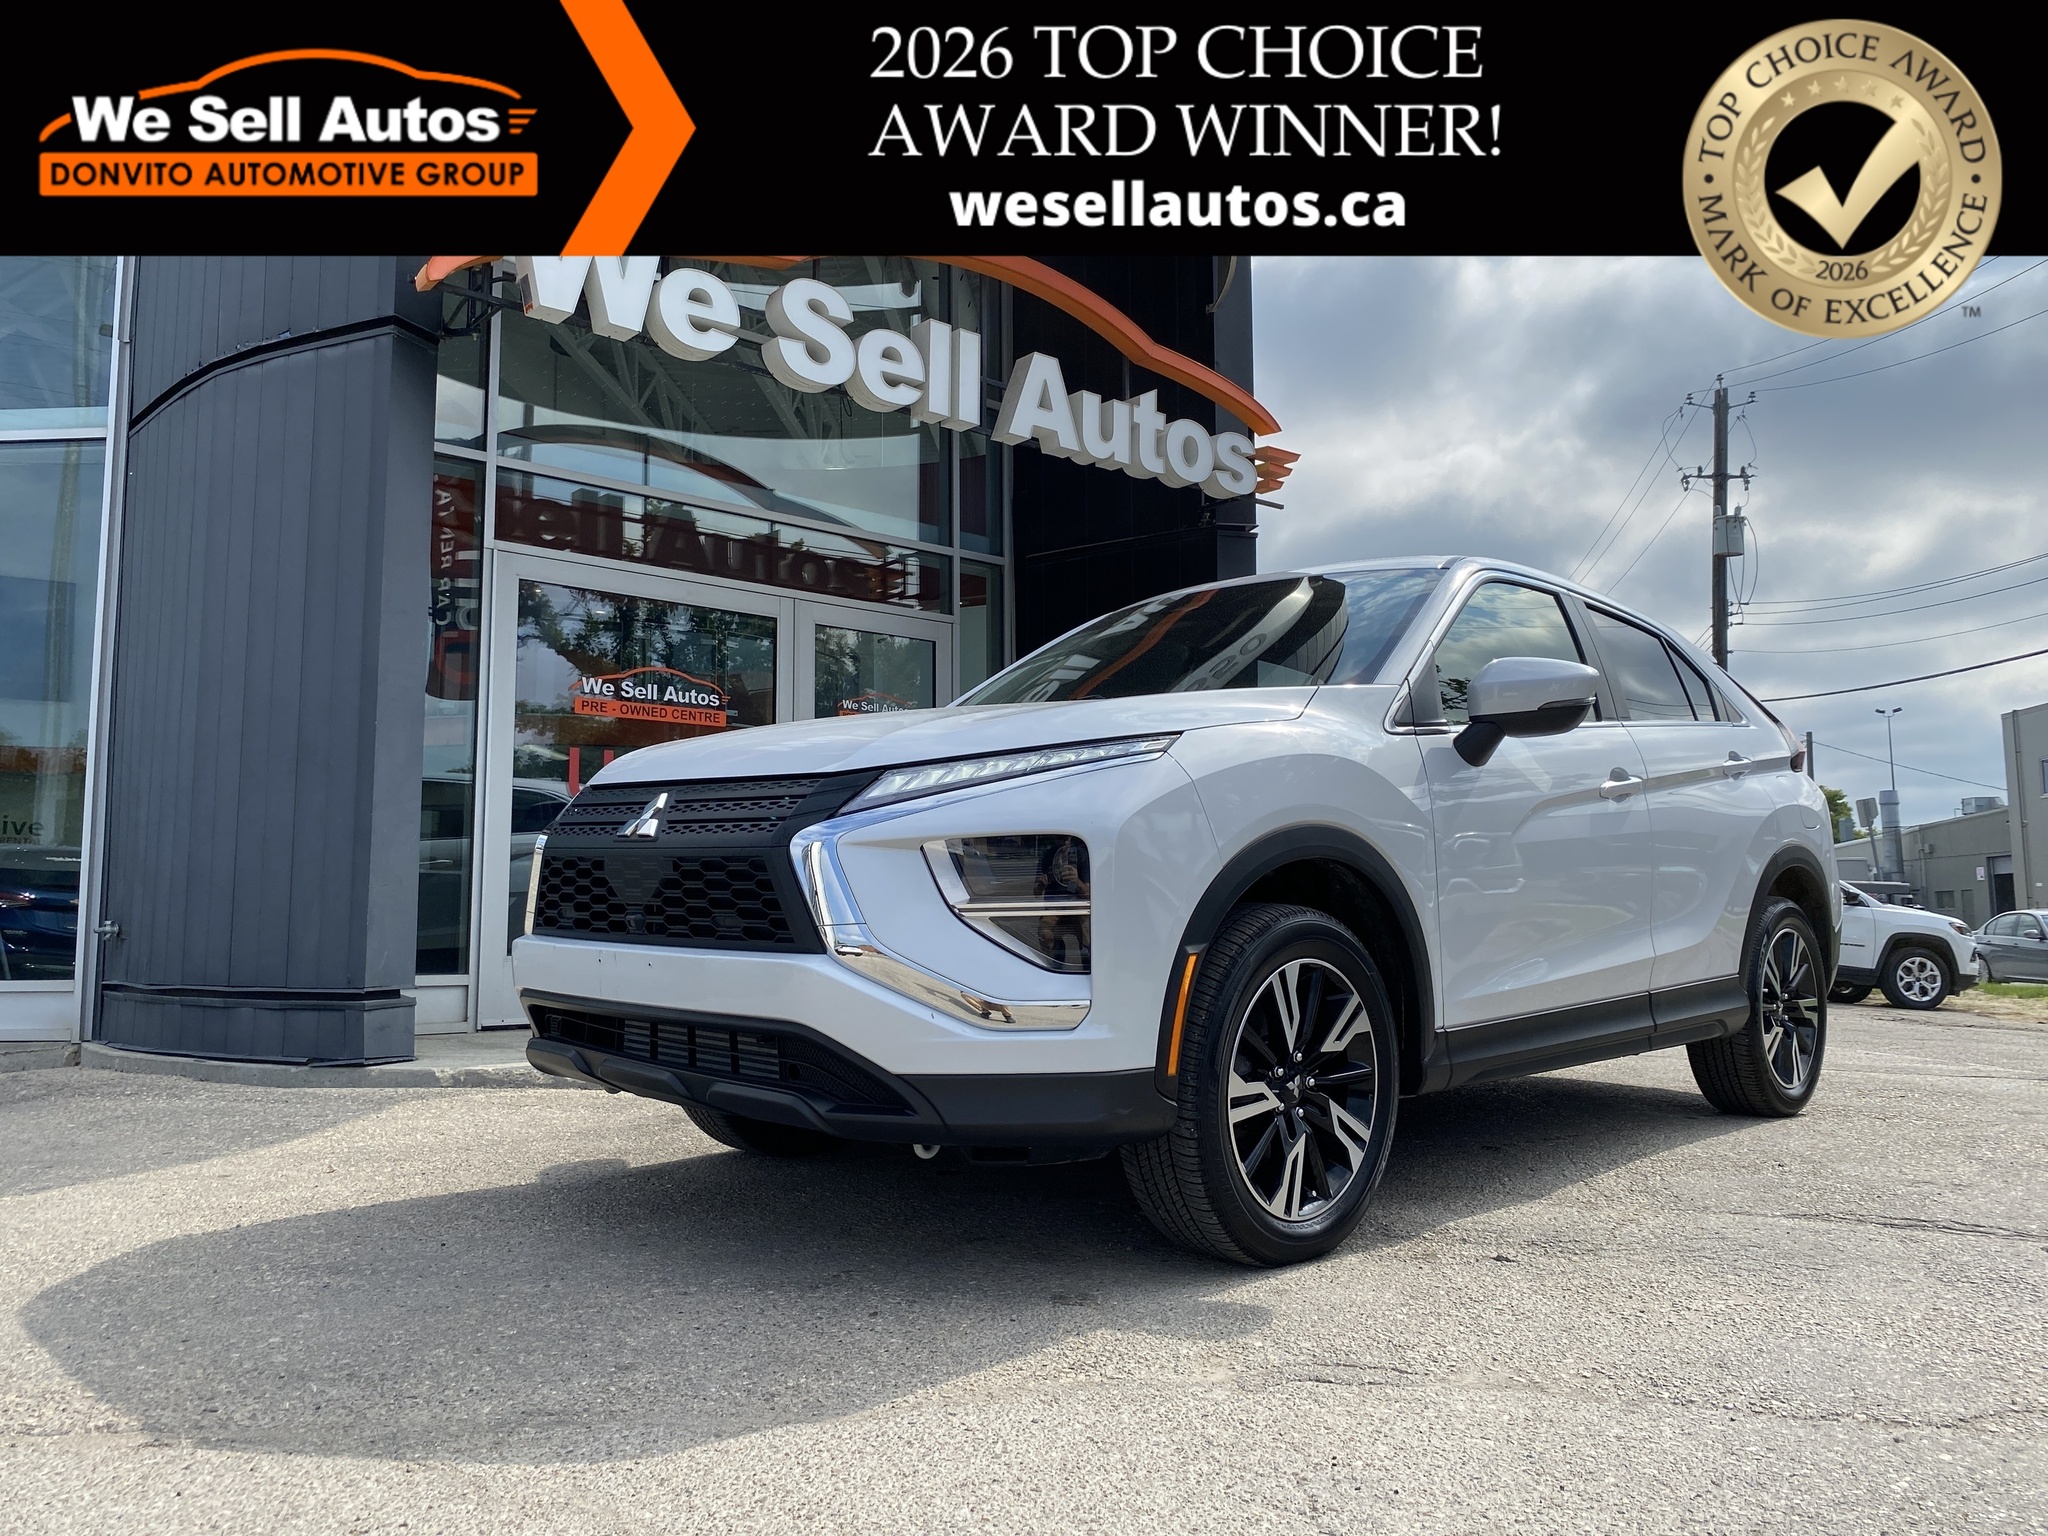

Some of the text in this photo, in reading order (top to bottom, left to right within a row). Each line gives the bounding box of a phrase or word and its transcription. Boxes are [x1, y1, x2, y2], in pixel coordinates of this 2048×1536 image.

[516, 256, 1258, 499] We Sell Autos
[581, 676, 720, 707] We Sell Autos
[581, 700, 608, 713] PRE
[620, 704, 668, 718] OWNED
[672, 707, 721, 723] CENTRE
[842, 699, 859, 710] We
[861, 701, 879, 712] Sell
